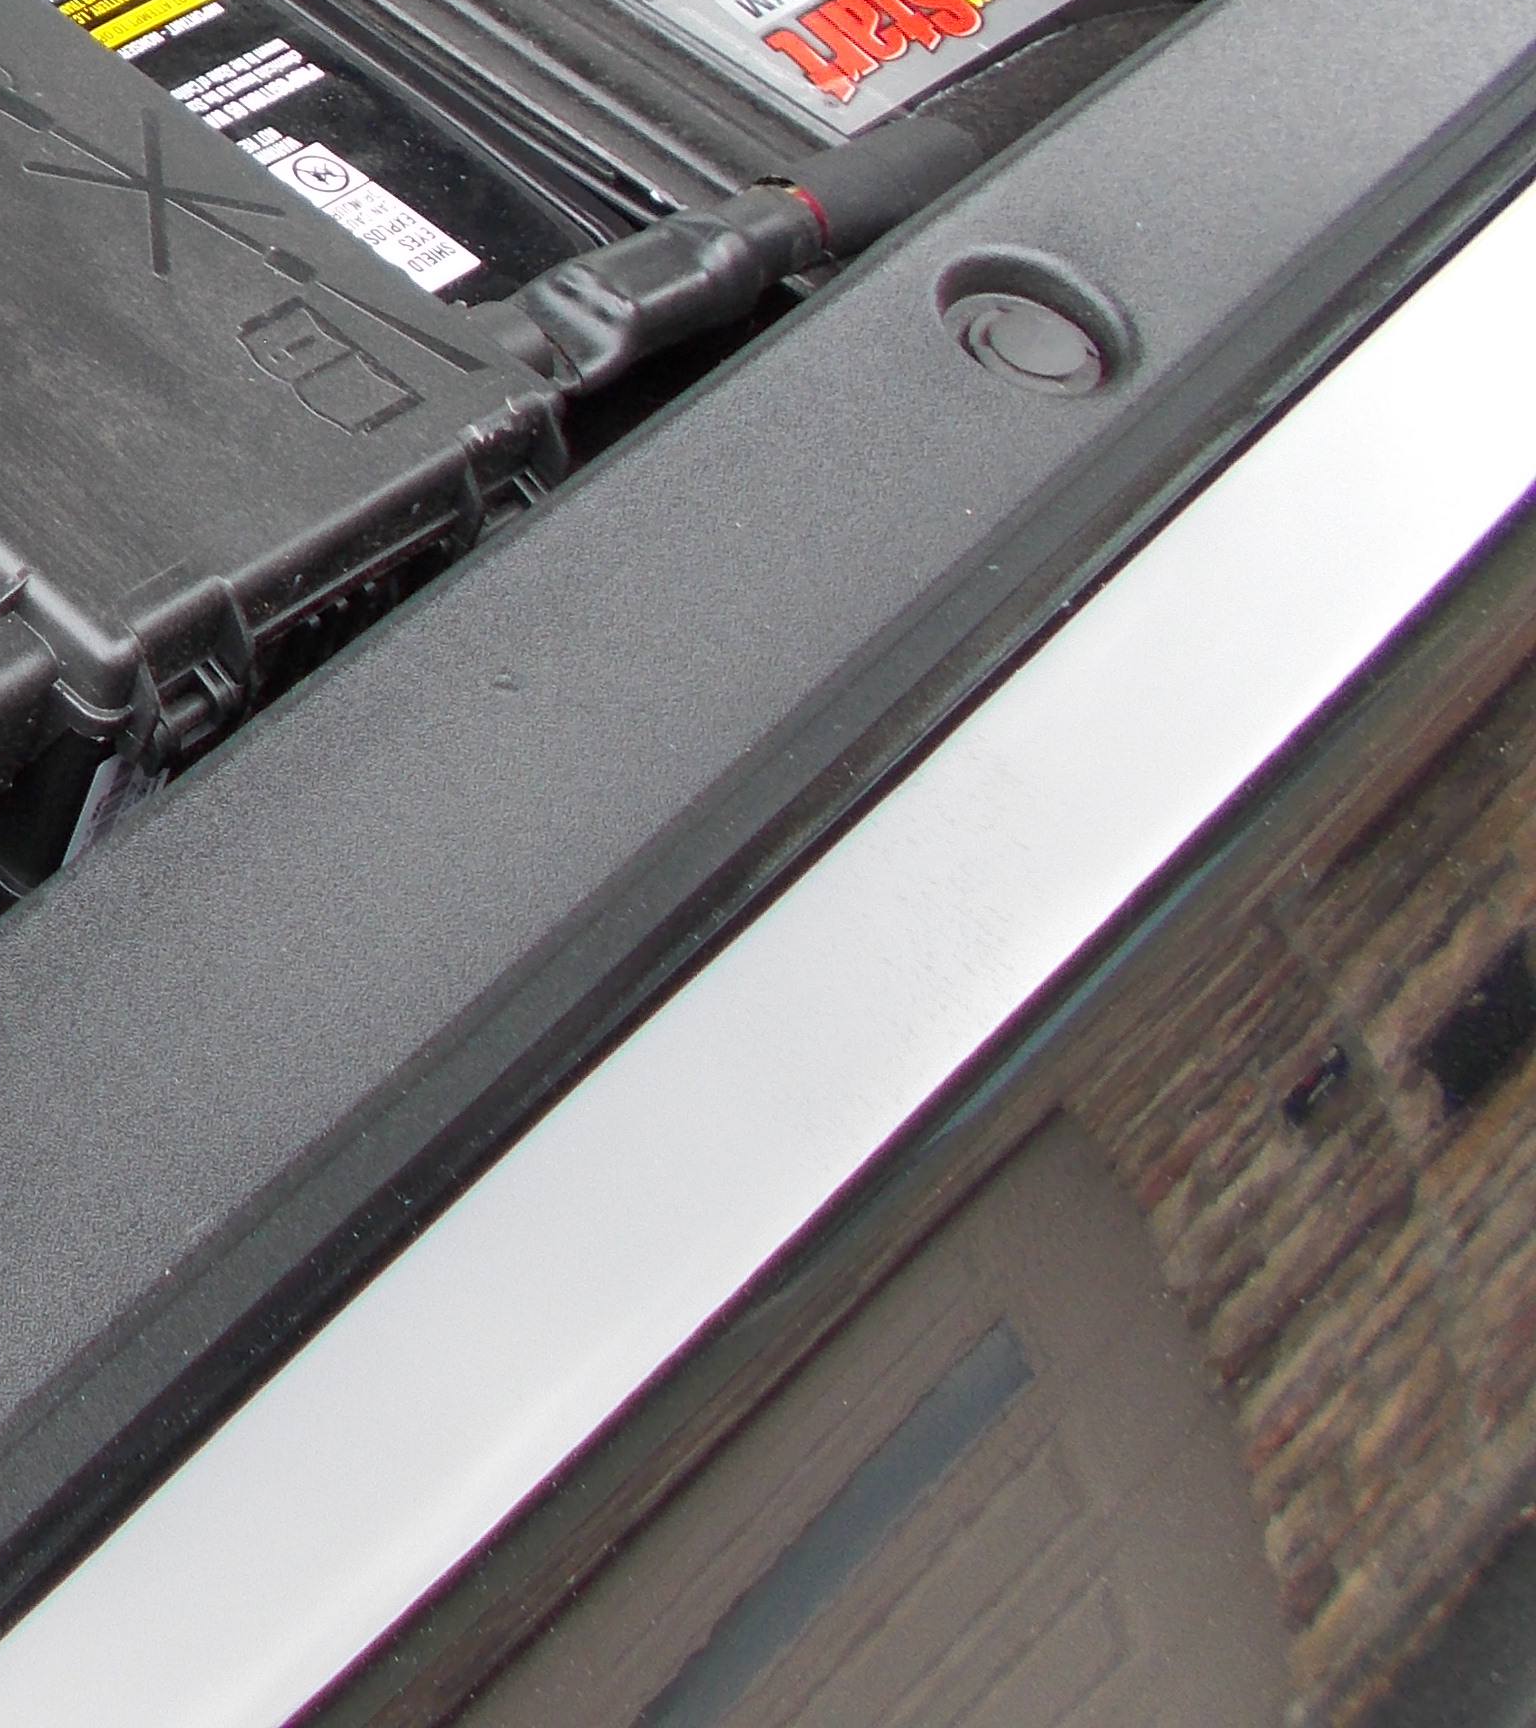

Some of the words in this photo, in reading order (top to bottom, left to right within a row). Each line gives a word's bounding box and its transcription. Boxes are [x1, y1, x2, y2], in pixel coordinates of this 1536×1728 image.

[123, 1, 174, 28] ATTEMPT
[162, 1, 226, 35] IMPORTANT
[110, 22, 130, 34] TO
[220, 100, 250, 119] 65
[250, 125, 283, 146] NOT
[360, 212, 417, 245] EXPLOS
[395, 226, 436, 251] EYES
[405, 241, 457, 272] SHIELD
